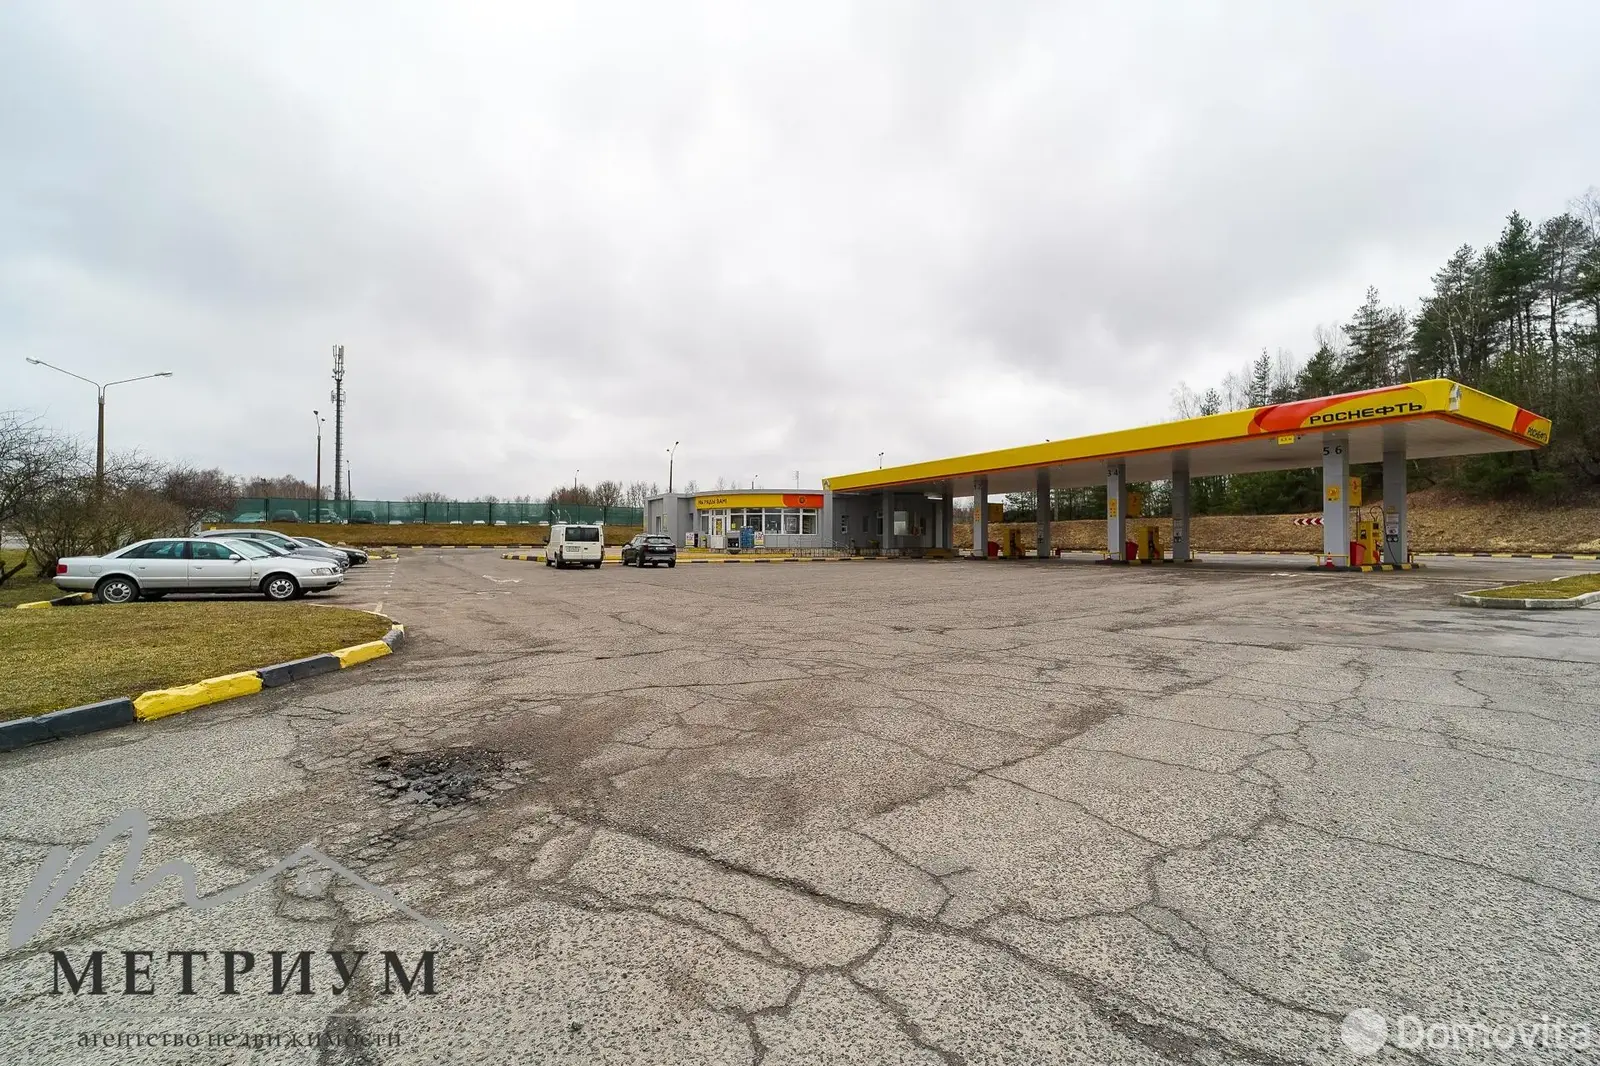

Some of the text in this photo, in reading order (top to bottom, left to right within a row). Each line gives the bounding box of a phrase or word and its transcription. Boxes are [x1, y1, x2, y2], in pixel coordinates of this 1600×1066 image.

[1309, 402, 1423, 425] РОСНЕФТЬ
[1323, 445, 1342, 455] 5 6
[1107, 469, 1112, 477] 3
